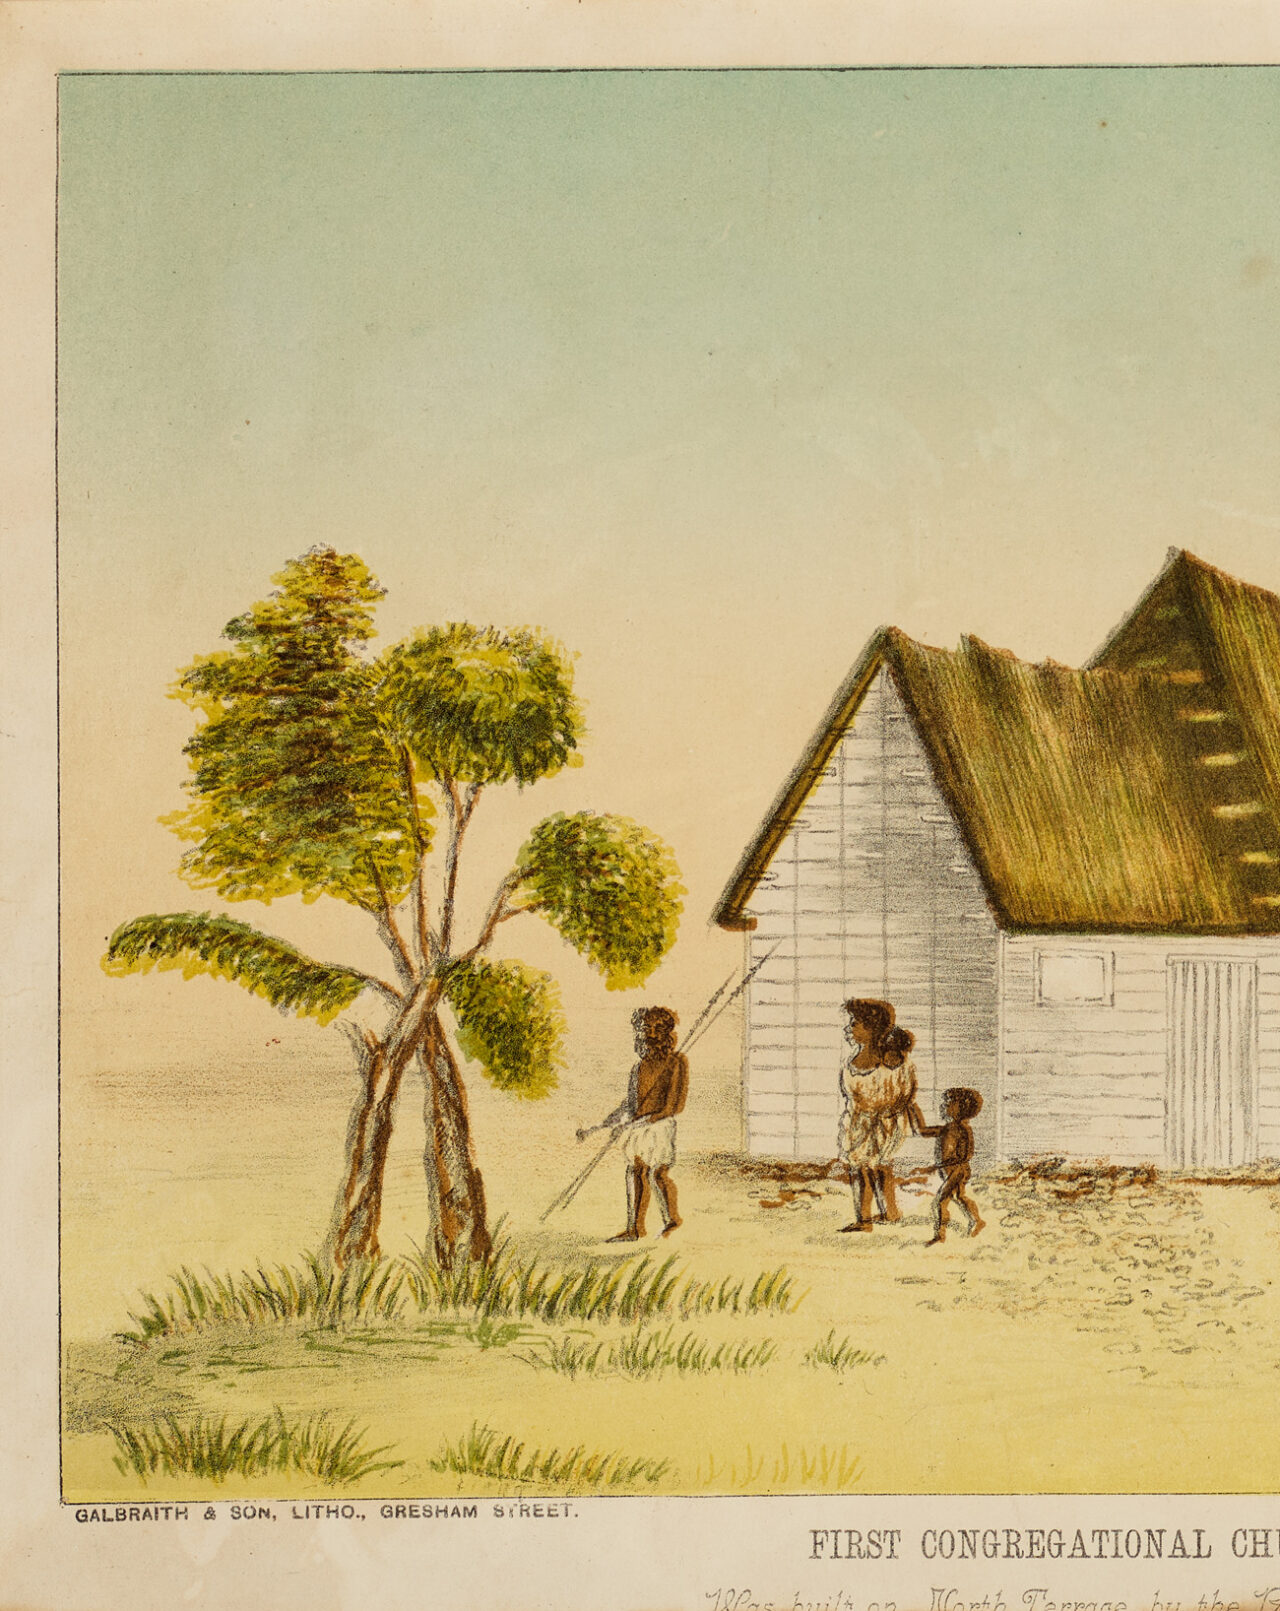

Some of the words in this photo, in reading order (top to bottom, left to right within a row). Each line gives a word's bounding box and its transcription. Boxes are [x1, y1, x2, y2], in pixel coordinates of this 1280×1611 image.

[74, 1505, 189, 1524] GALBRAITH
[203, 1505, 217, 1521] &
[229, 1504, 277, 1522] SON,
[291, 1504, 366, 1522] LITHO.,
[379, 1504, 478, 1520] GRESHAM
[492, 1501, 579, 1519] STREET.
[808, 1528, 902, 1560] FIRST
[920, 1528, 1213, 1560] CONGREGATIONAL
